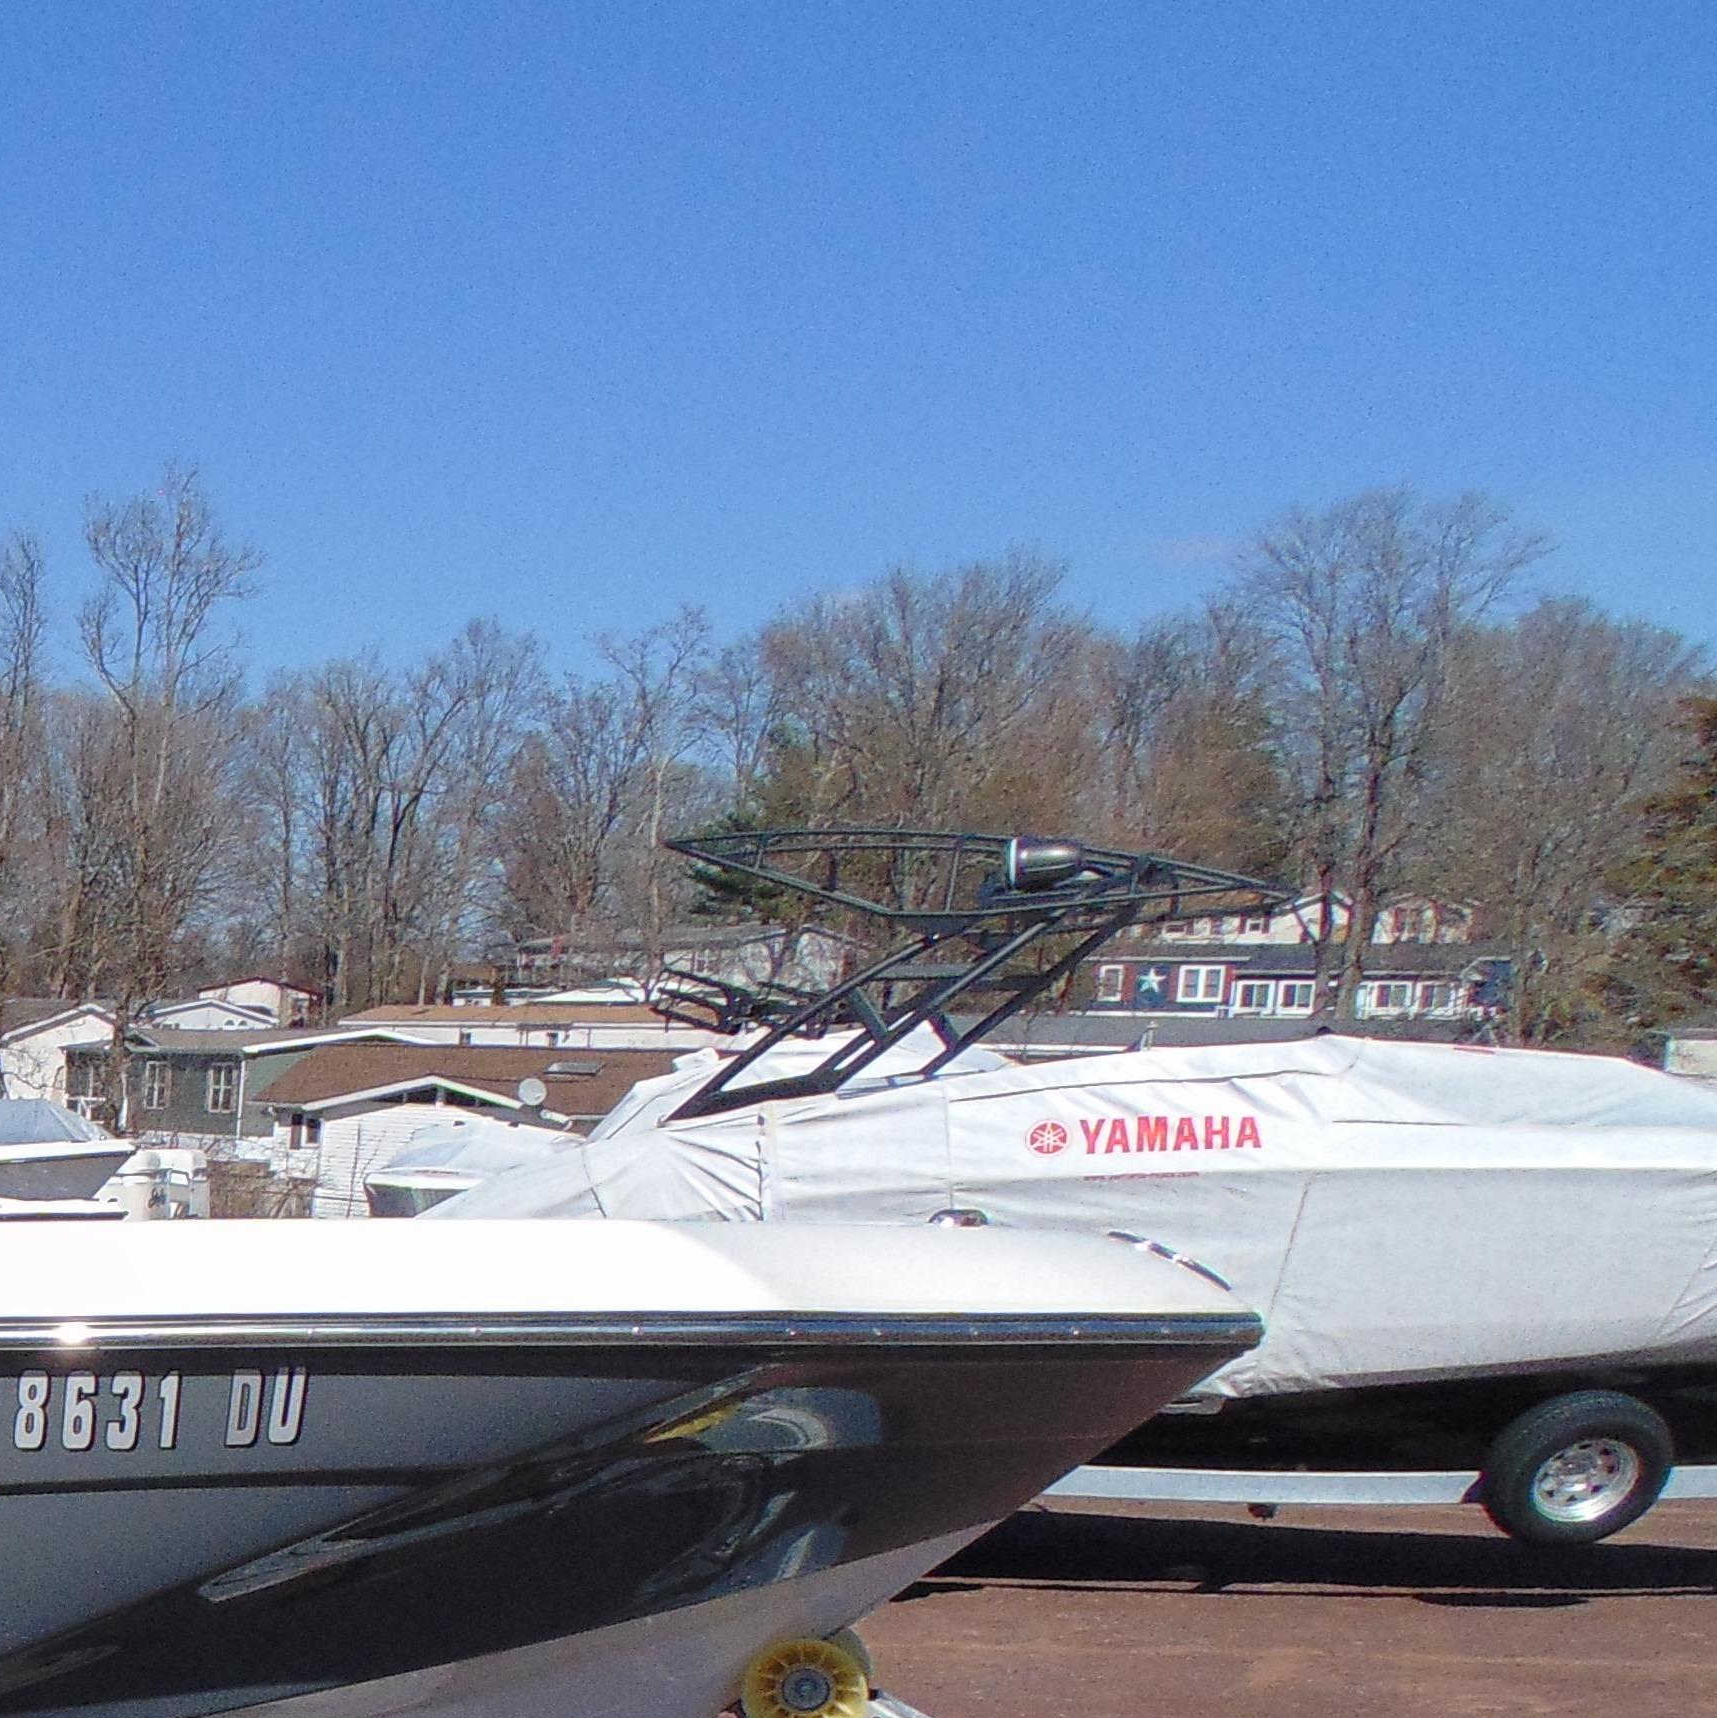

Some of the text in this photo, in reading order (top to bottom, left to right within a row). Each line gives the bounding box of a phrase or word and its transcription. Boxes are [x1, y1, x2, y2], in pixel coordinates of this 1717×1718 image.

[1079, 1116, 1262, 1154] YAMAHA
[13, 1370, 182, 1452] 8631
[224, 1366, 309, 1449] DU
